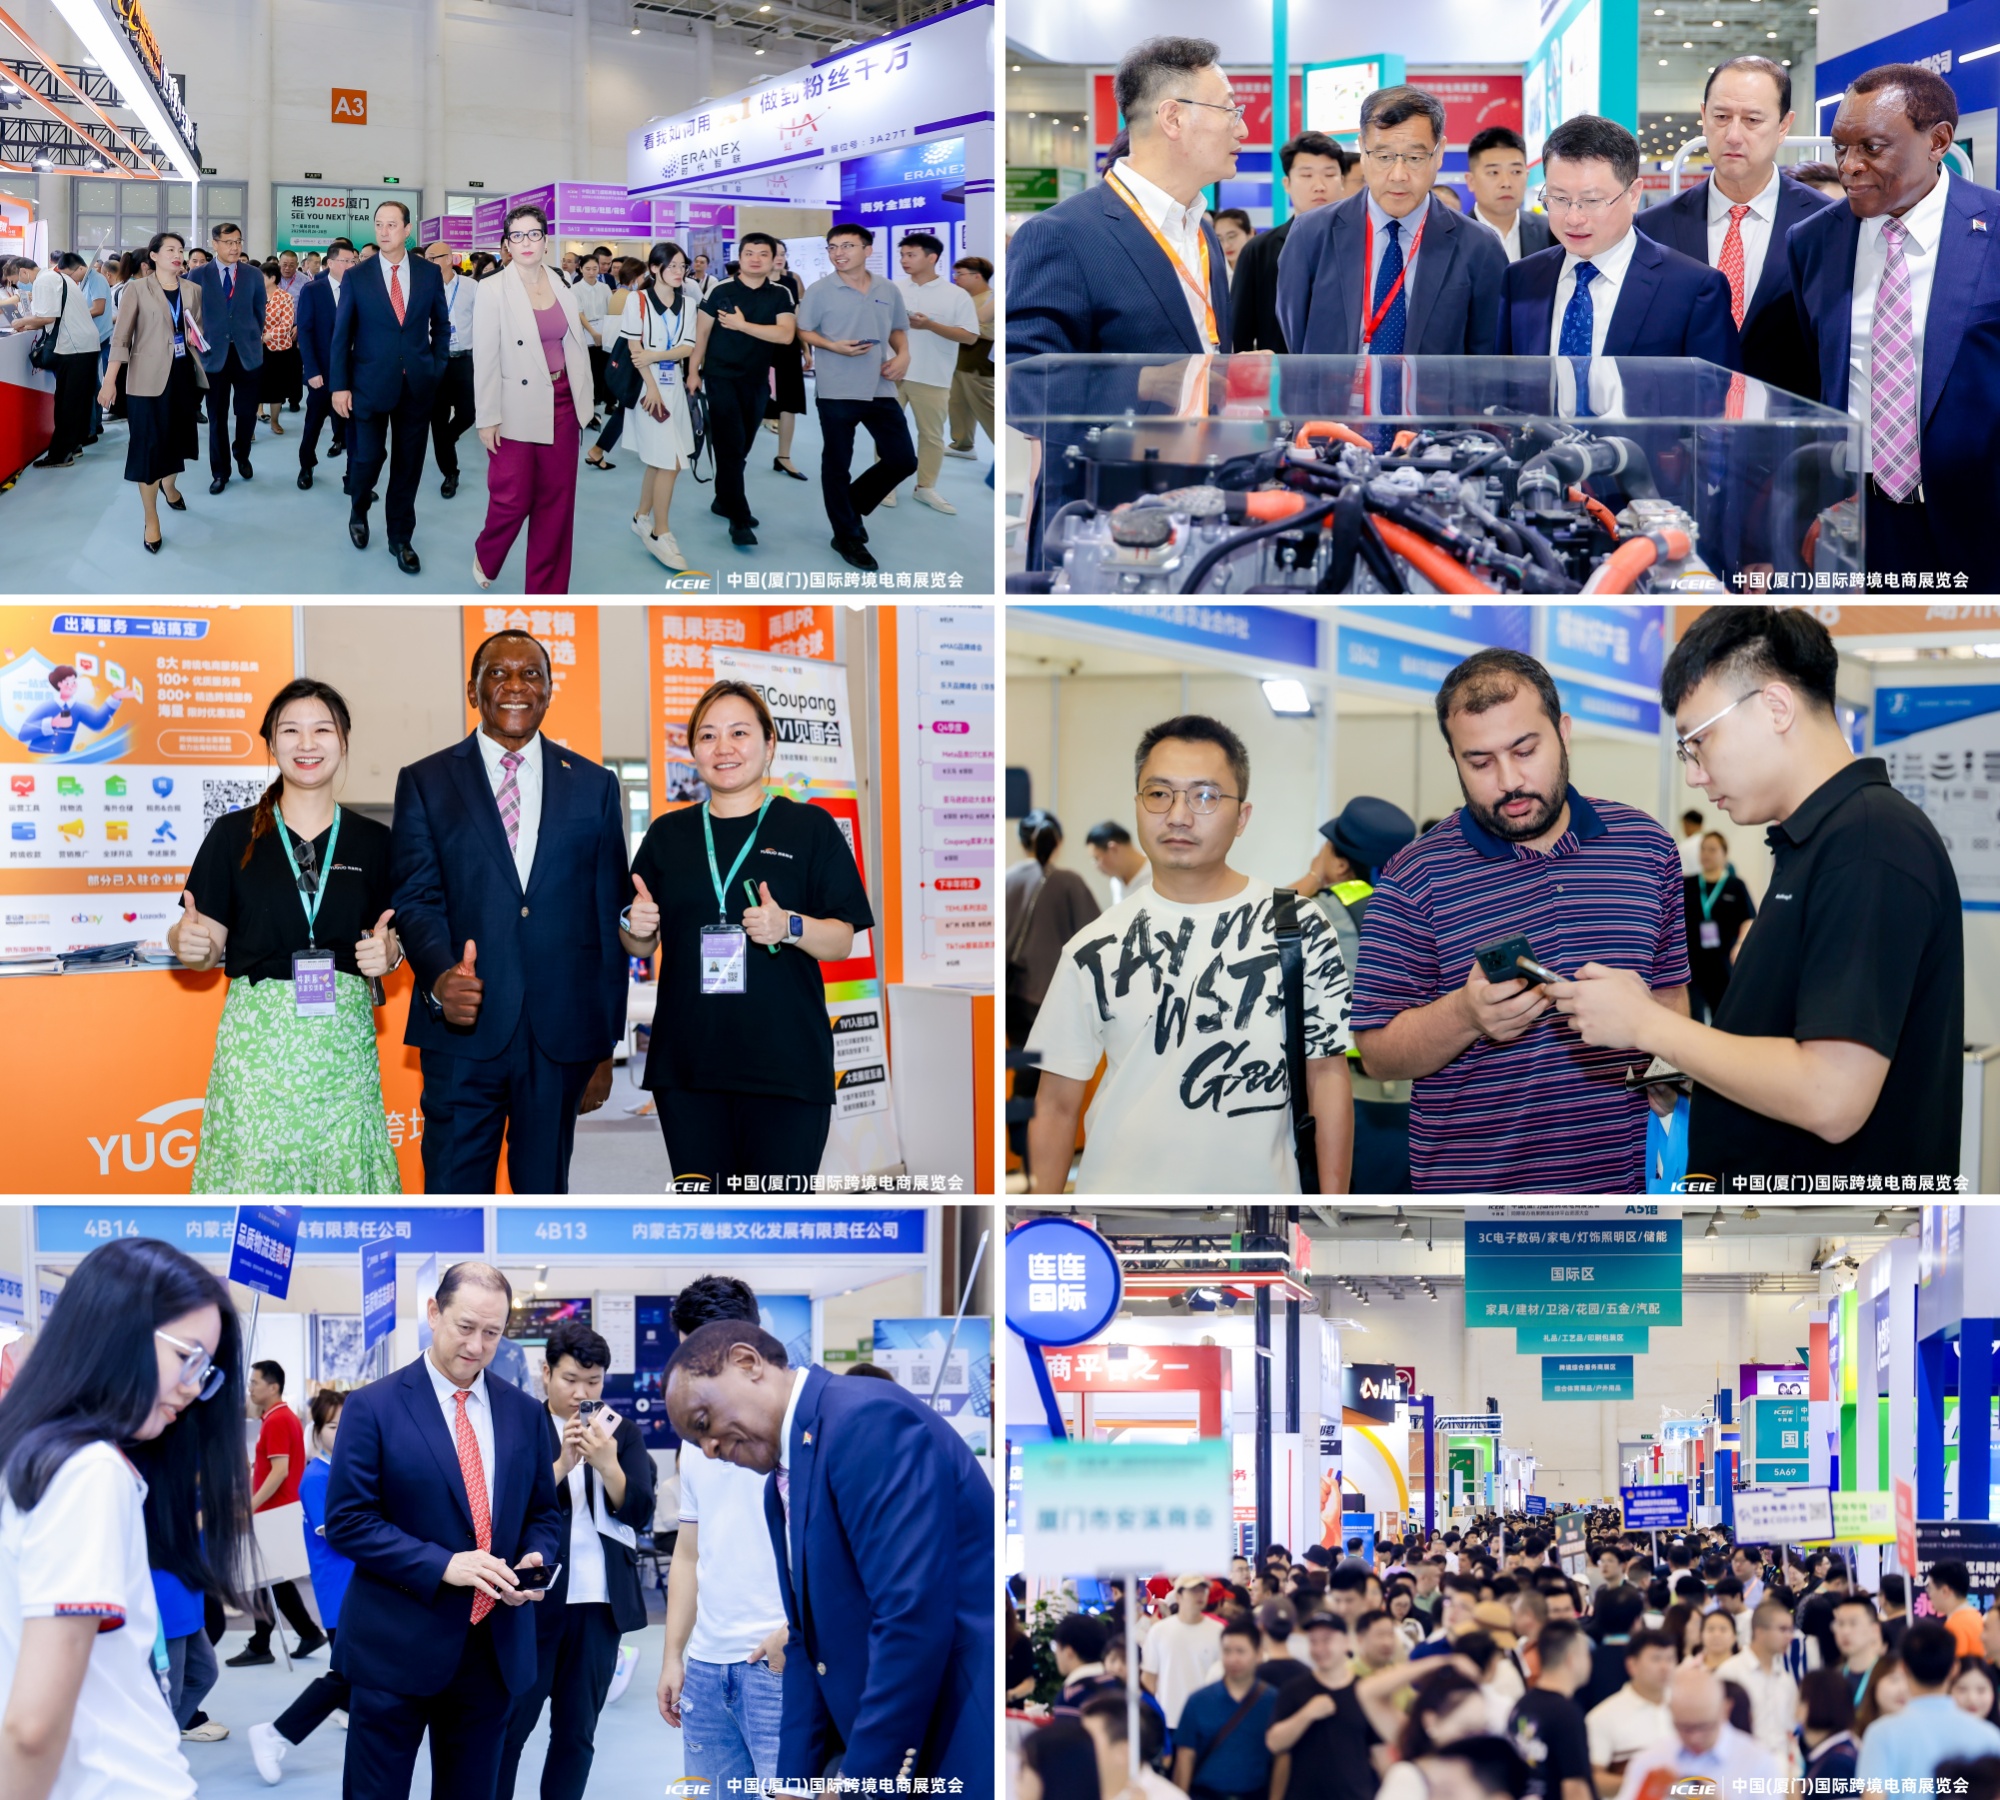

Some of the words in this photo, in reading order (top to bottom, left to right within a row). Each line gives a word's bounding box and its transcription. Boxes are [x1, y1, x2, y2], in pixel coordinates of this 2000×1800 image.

[643, 113, 711, 152] 看我如何用
[759, 41, 912, 115] 做到粉丝千万
[334, 96, 365, 117] A3
[681, 140, 741, 165] ERANEX
[291, 195, 370, 210] 相约2025厦门
[291, 212, 305, 220] SEE
[64, 616, 128, 634] 出海服务
[135, 619, 197, 637] 一站搞定
[157, 672, 190, 685] 100+
[157, 688, 192, 702] 800+
[71, 913, 103, 925] ebay
[139, 912, 167, 920] Lazada
[84, 1219, 140, 1238] 4B14
[534, 1221, 588, 1240] 4B13
[632, 1221, 899, 1240] 内蒙古万卷楼文化发展有限责任公司
[1478, 1230, 1668, 1244] 3C电子数码/家电/灯饰照明区/储能
[1028, 1252, 1086, 1281] 连连
[1550, 1266, 1595, 1282] 国际区
[1029, 1283, 1087, 1312] 国际
[1486, 1302, 1661, 1316] 家具/建材/卫浴/花园/五金/汽配
[1543, 1334, 1624, 1342] 礼品/工艺品/印刷包装区
[1773, 1468, 1797, 1476] 5A69
